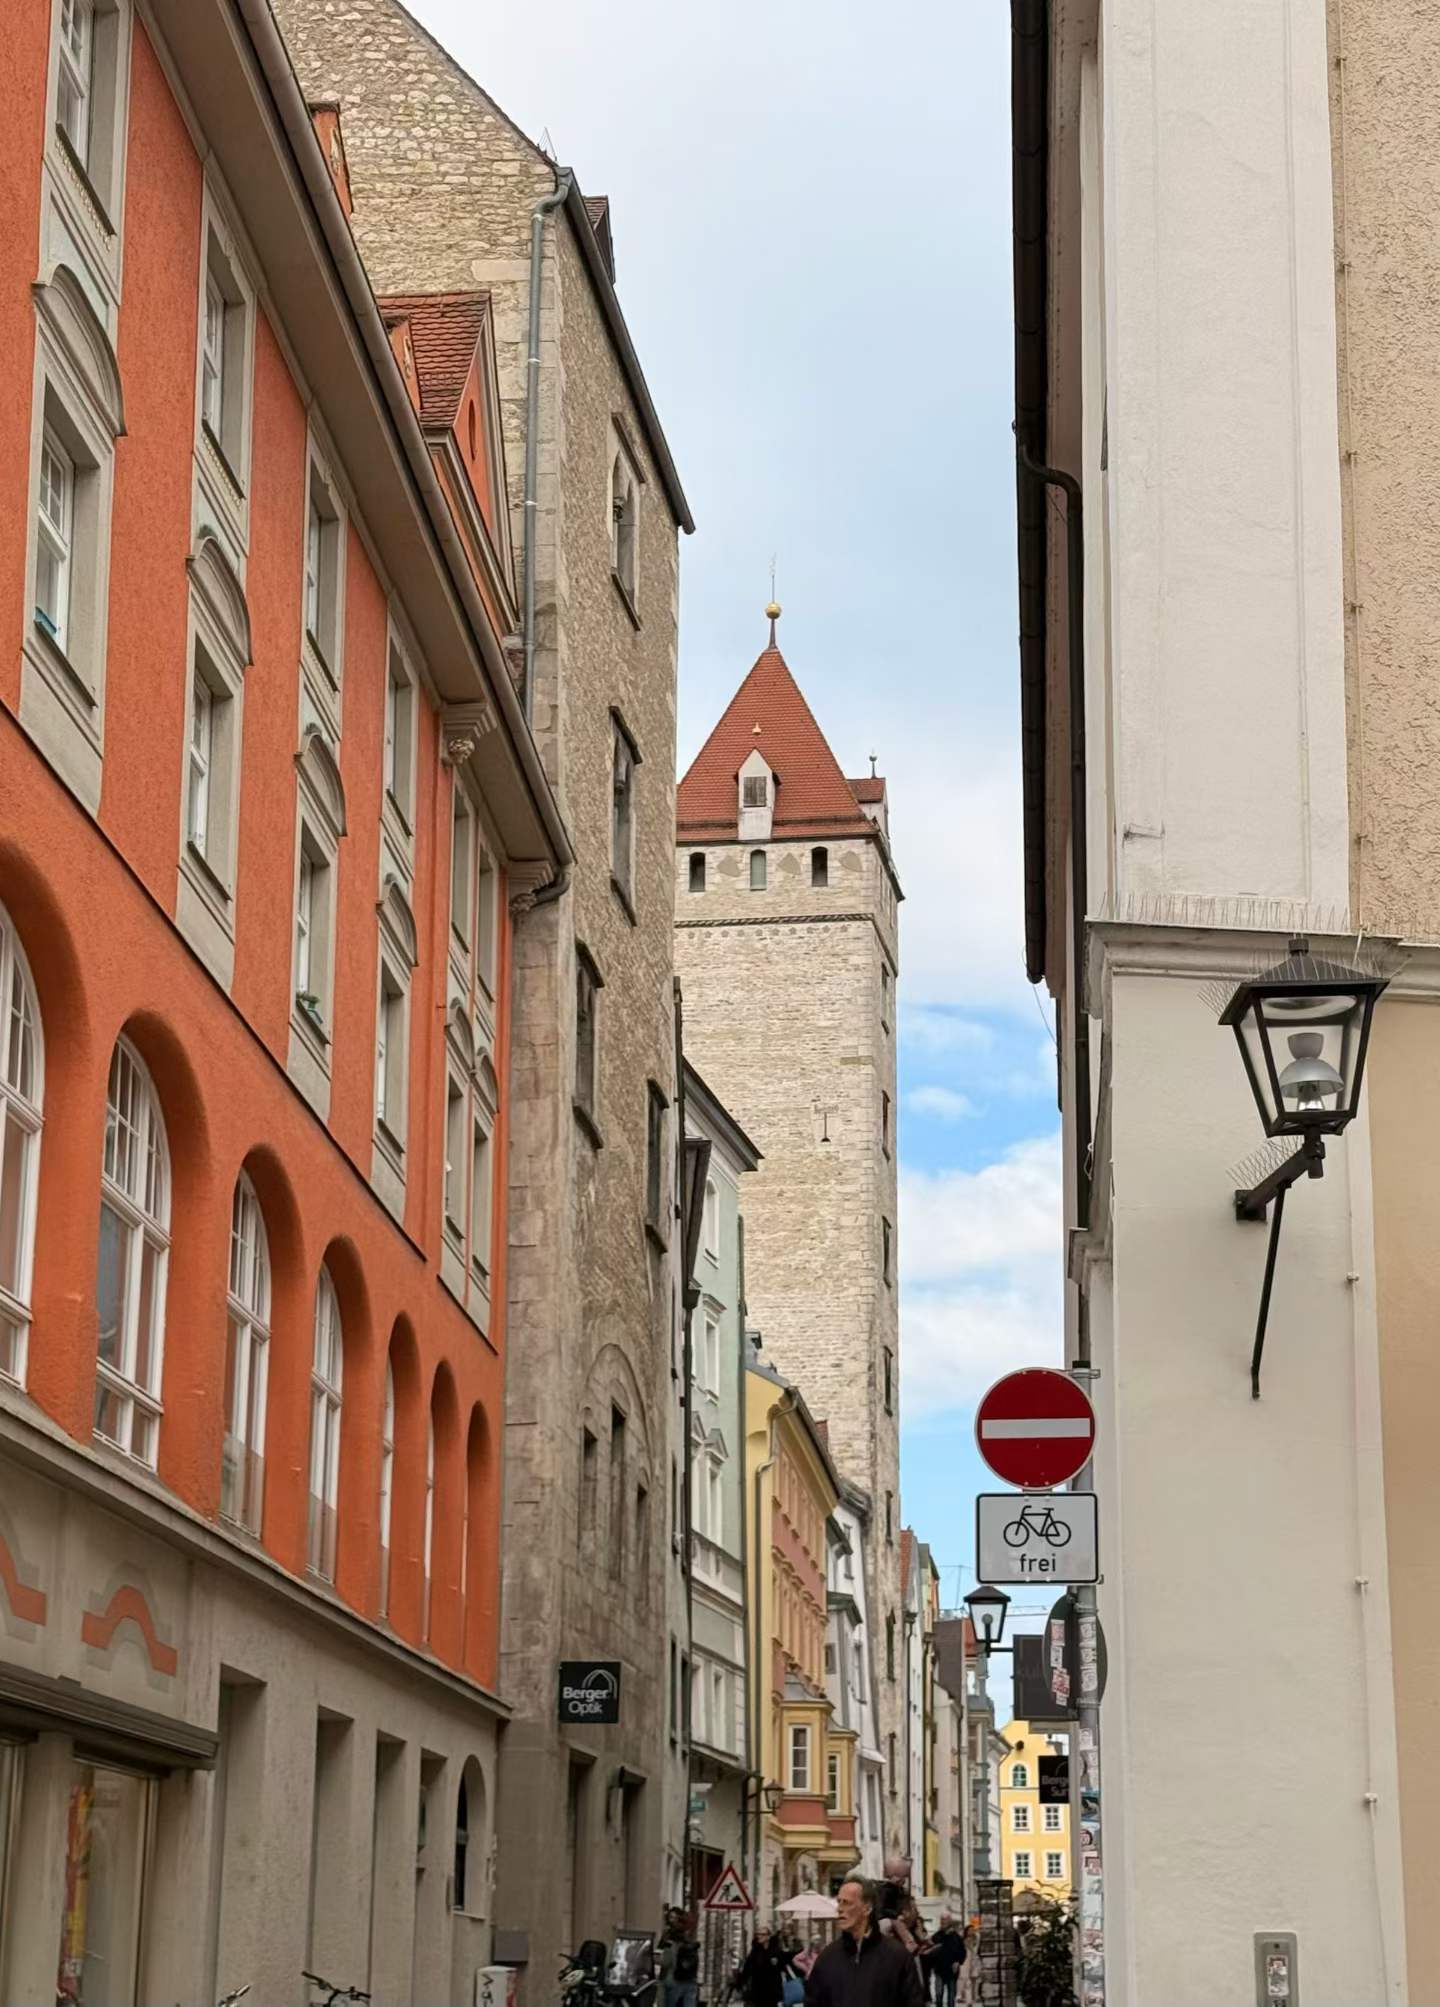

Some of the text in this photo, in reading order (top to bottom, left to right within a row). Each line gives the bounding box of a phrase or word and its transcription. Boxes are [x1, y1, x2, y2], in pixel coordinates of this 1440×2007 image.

[1020, 1553, 1056, 1572] frei
[563, 1686, 609, 1702] Berger
[568, 1700, 603, 1717] Optik
